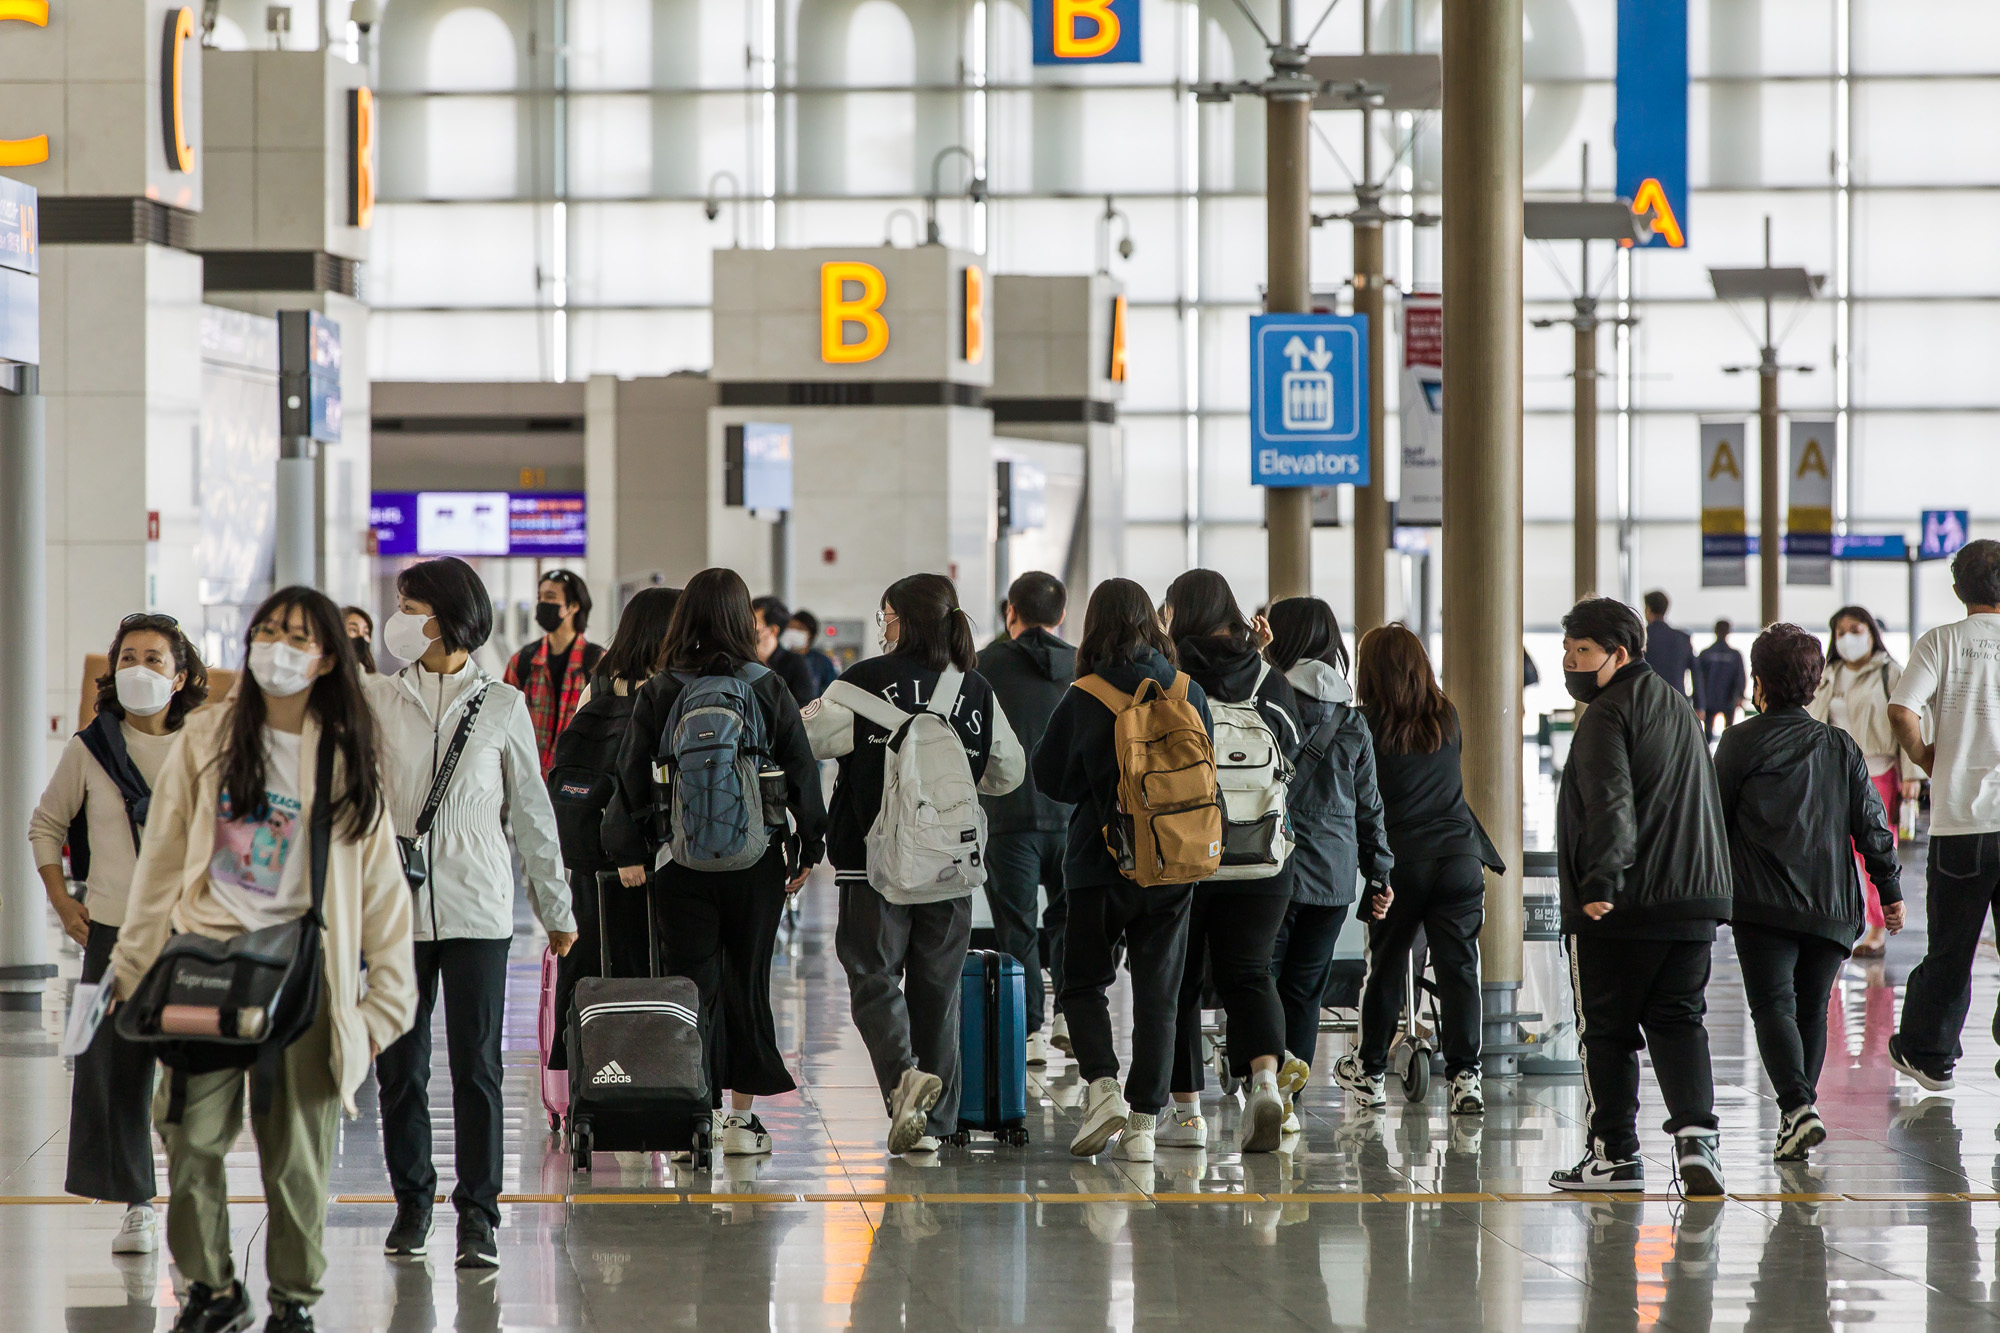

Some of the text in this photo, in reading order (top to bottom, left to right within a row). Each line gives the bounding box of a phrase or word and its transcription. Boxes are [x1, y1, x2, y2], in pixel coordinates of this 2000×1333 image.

[1053, 0, 1120, 58] B
[1617, 178, 1685, 248] A
[821, 261, 889, 363] B
[1258, 448, 1360, 475] Elevators
[1707, 438, 1740, 481] A
[1796, 437, 1829, 480] A
[592, 1073, 632, 1084] adidas
